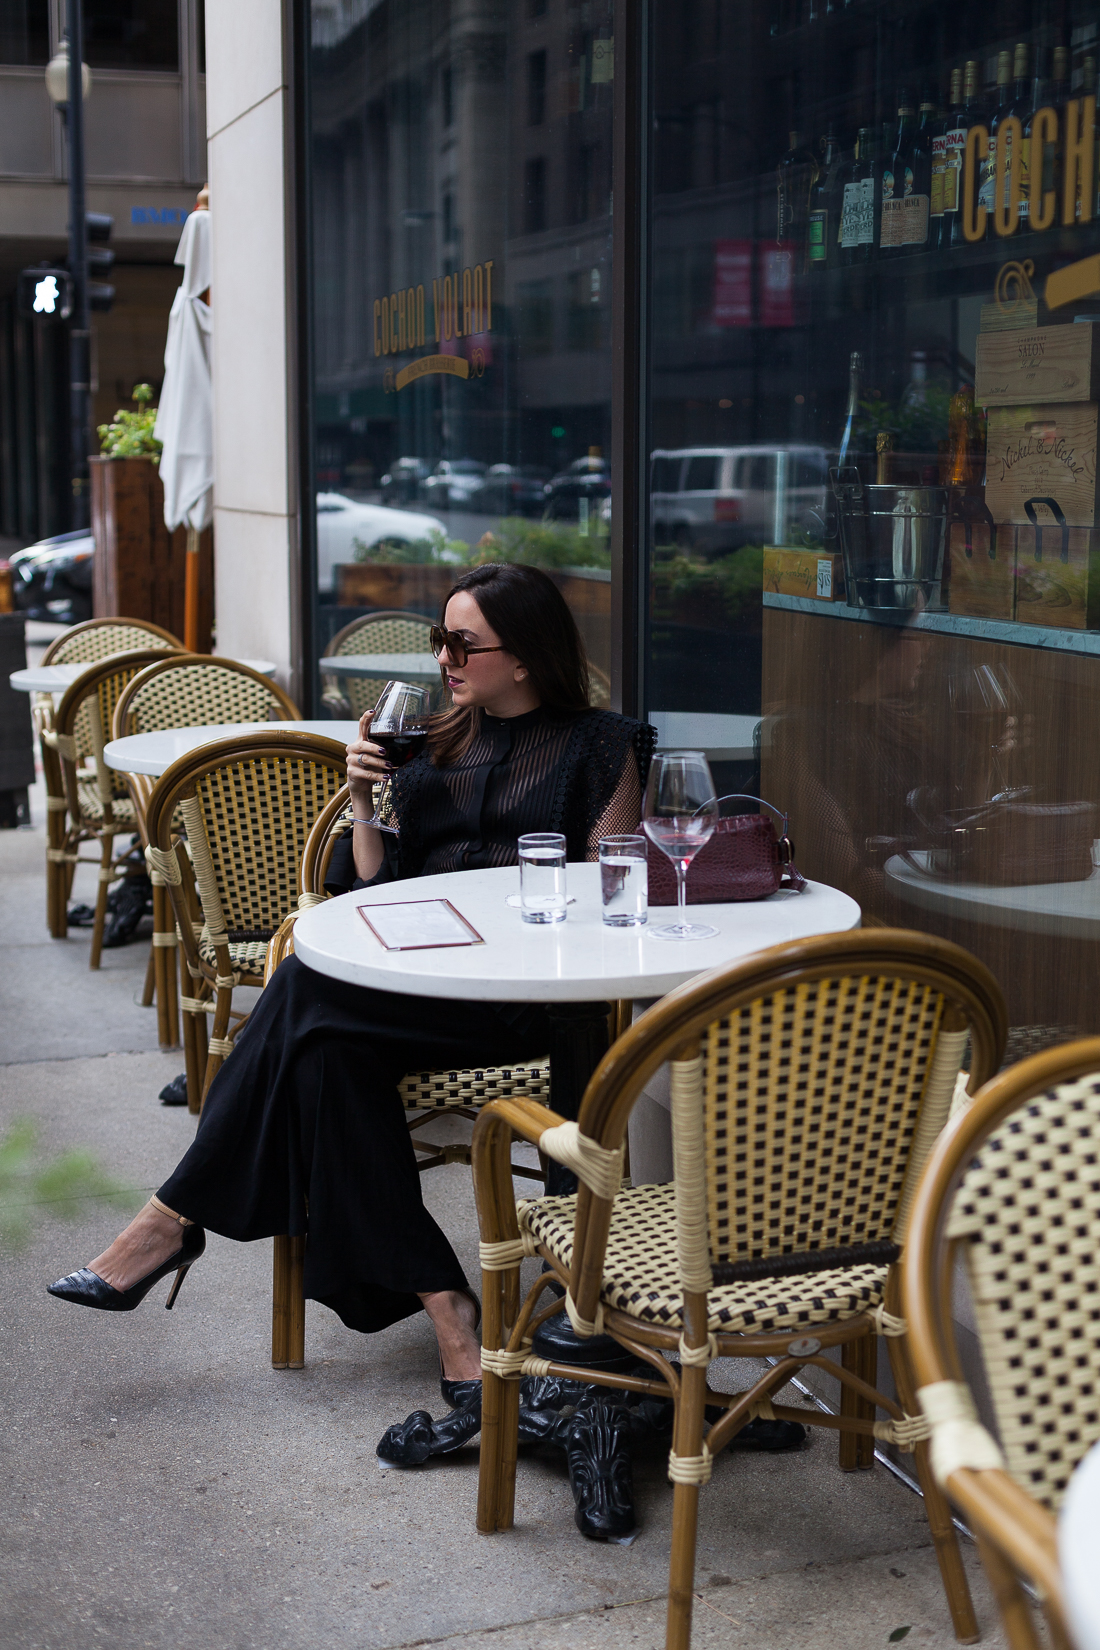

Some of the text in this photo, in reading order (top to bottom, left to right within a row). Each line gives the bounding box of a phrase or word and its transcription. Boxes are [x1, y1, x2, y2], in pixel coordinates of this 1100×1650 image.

[373, 260, 493, 357] COCHON VOLANT
[1018, 342, 1045, 358] SALON
[1000, 435, 1084, 483] Nickel & Nickel
